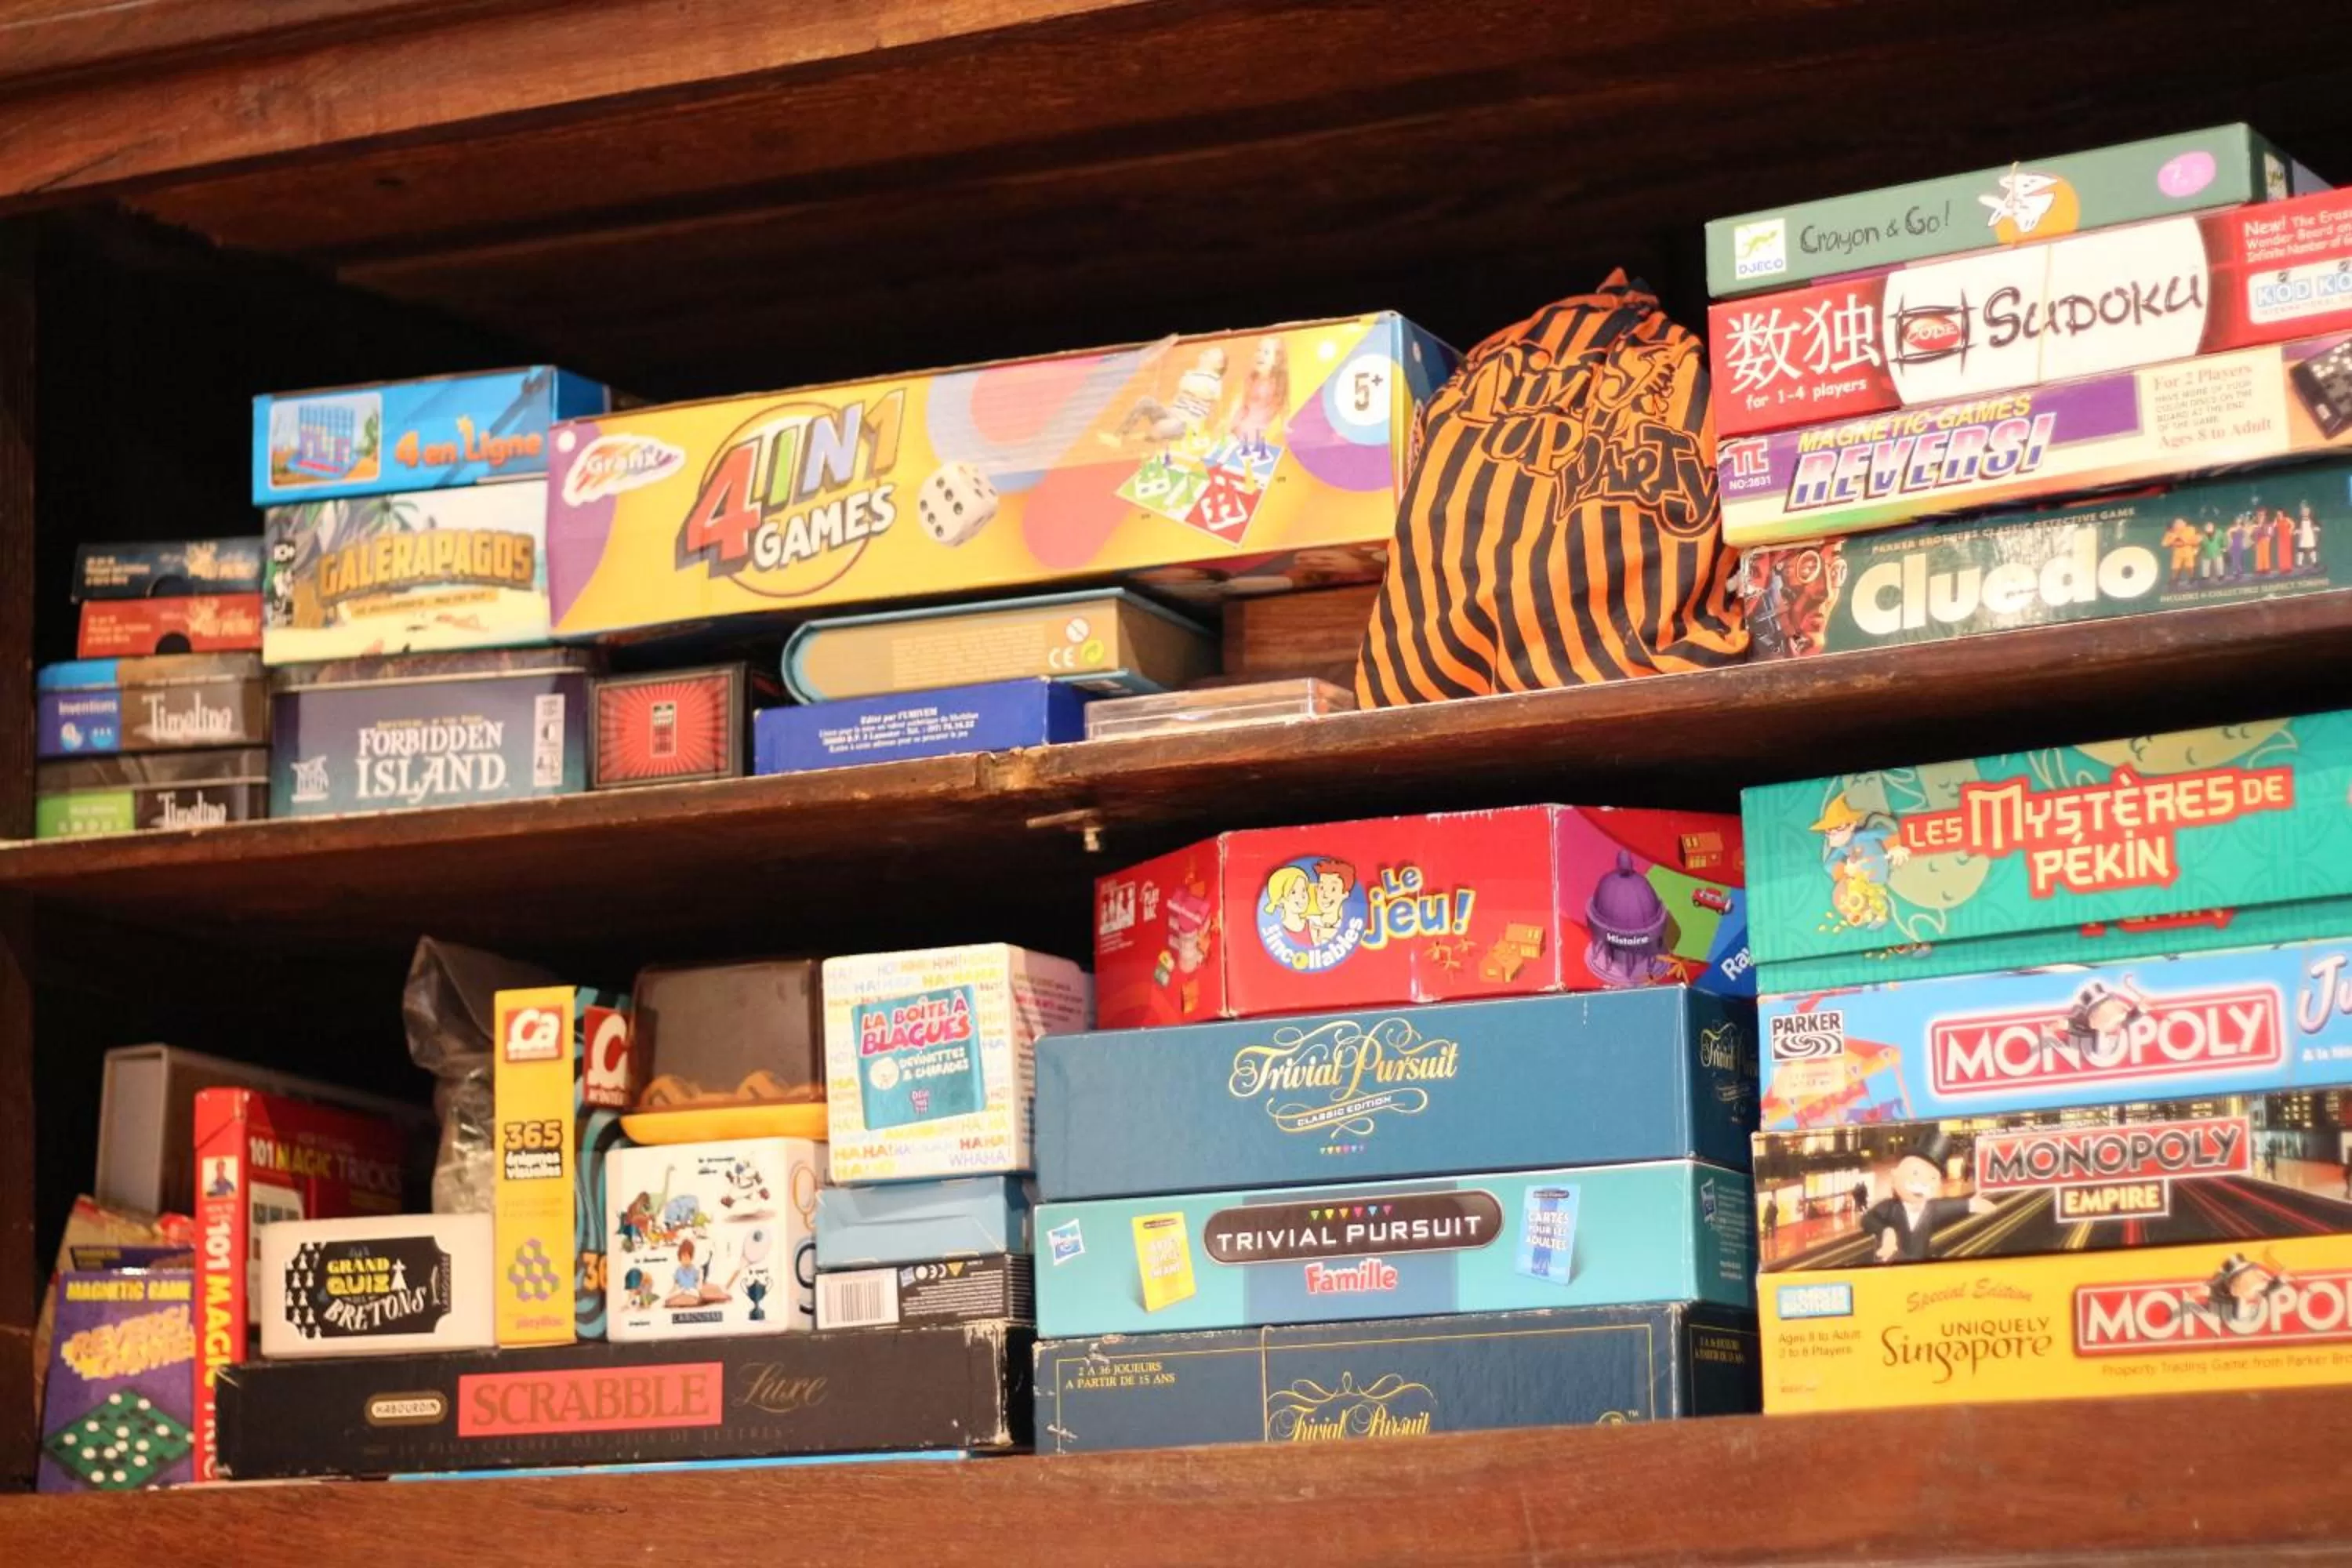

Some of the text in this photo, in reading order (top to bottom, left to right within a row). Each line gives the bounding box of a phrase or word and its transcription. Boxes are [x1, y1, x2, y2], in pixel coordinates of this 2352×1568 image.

[1799, 224, 1880, 255] Crayon
[1886, 223, 1899, 237] &
[1737, 257, 1785, 276] DJECO
[1725, 292, 1882, 395] 数独
[1745, 378, 1868, 411] for 1-4 players
[395, 417, 543, 466] 4 en Ligne
[1797, 394, 2032, 454] MAGNETIC GAMES
[1554, 423, 1723, 533] PARTY
[1786, 412, 2056, 511] REVERSI
[753, 485, 898, 570] GAMES
[2099, 506, 2136, 522] GAME
[58, 699, 118, 716] Inventions
[358, 721, 505, 757] FORBIDDEN
[355, 752, 508, 804] ISLAND
[1907, 816, 1963, 849] LES
[2242, 775, 2285, 804] DE
[2032, 829, 2172, 892] PÉKIN
[1381, 867, 1422, 895] Le
[1606, 932, 1650, 946] Histoire
[863, 989, 969, 1030] LA BOÎTE À
[1772, 1012, 1842, 1036] PARKER
[862, 1014, 973, 1056] BLAGUES
[1944, 1002, 2266, 1083] MONOPOLY
[1230, 1021, 1459, 1101] Trivial Pursuit
[1297, 1094, 1392, 1127] CLASSIC EDITION
[505, 1119, 563, 1150] 365
[1984, 1123, 2244, 1185] MONOPOLY
[2063, 1184, 2162, 1213] EMPIRE
[204, 1225, 231, 1270] 101
[1216, 1215, 1482, 1252] TRIVIAL PURSUIT
[325, 1272, 390, 1296] QUIZ
[326, 1257, 390, 1274] GRAND
[1304, 1257, 1398, 1294] Famille
[66, 1279, 144, 1303] MAGNETIC
[323, 1286, 427, 1331] BRETONS
[1906, 1277, 2033, 1313] Special Edition
[1940, 1316, 2051, 1337] UNIQUELY
[1113, 1361, 1163, 1376] JOUEURS
[1881, 1324, 2053, 1384] Singapore
[2101, 1363, 2155, 1378] Property
[2160, 1360, 2207, 1374] Trading
[2210, 1357, 2248, 1371] Game
[2252, 1356, 2283, 1369] from
[2286, 1352, 2328, 1367] Parker
[472, 1362, 828, 1426] SCRABBLE Luxe
[1076, 1376, 1117, 1389] PARTIR
[1120, 1376, 1136, 1387] DE
[1153, 1373, 1176, 1385] ANS
[1269, 1404, 1348, 1443] Trivial
